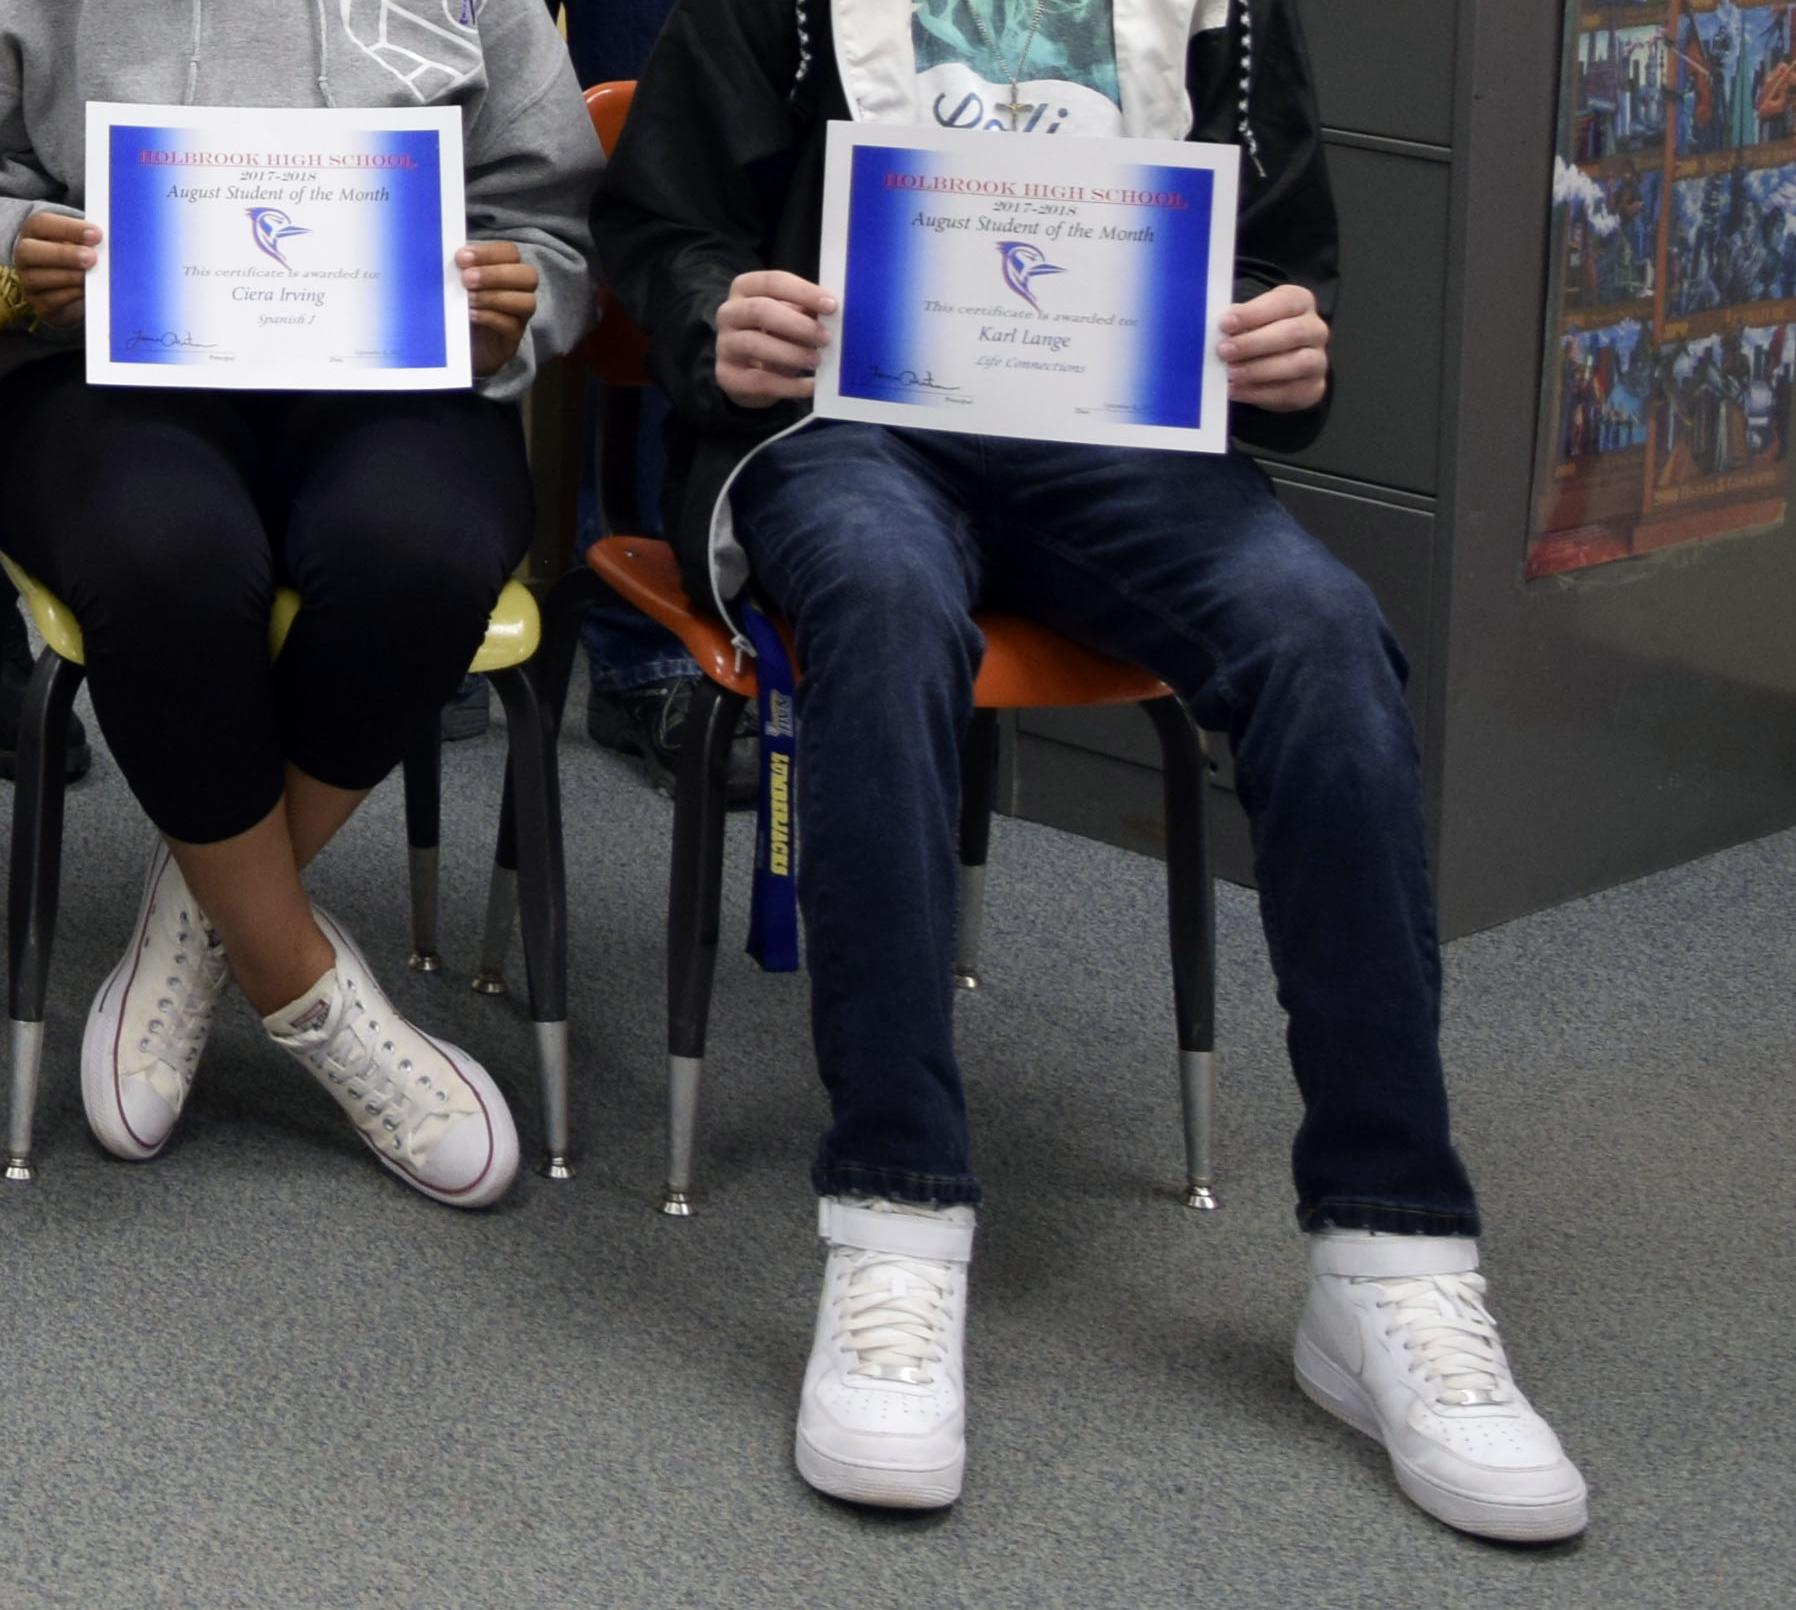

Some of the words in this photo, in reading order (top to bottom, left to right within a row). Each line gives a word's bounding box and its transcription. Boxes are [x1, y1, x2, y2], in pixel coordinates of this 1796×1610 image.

[139, 151, 260, 165] HOLBROOK
[266, 153, 322, 166] HIGH
[328, 154, 414, 168] SCHOOL
[238, 169, 318, 182] 2017-2018
[165, 183, 221, 203] August
[225, 184, 284, 200] Student
[288, 185, 308, 205] of
[309, 185, 333, 201] the
[336, 185, 390, 202] Month
[883, 172, 1016, 196] HOLBROOK
[1022, 182, 1084, 200] HIGH
[1090, 187, 1184, 208] SCHOOL
[990, 199, 1078, 217] 2017-2018
[909, 210, 971, 235] August
[975, 214, 1040, 235] Student
[1044, 219, 1066, 241] of
[1067, 220, 1093, 239] the
[1097, 222, 1156, 244] Month
[230, 286, 273, 301] Ciera
[279, 286, 325, 307] Irving
[978, 325, 1017, 344] Karl
[1021, 328, 1071, 353] Lange
